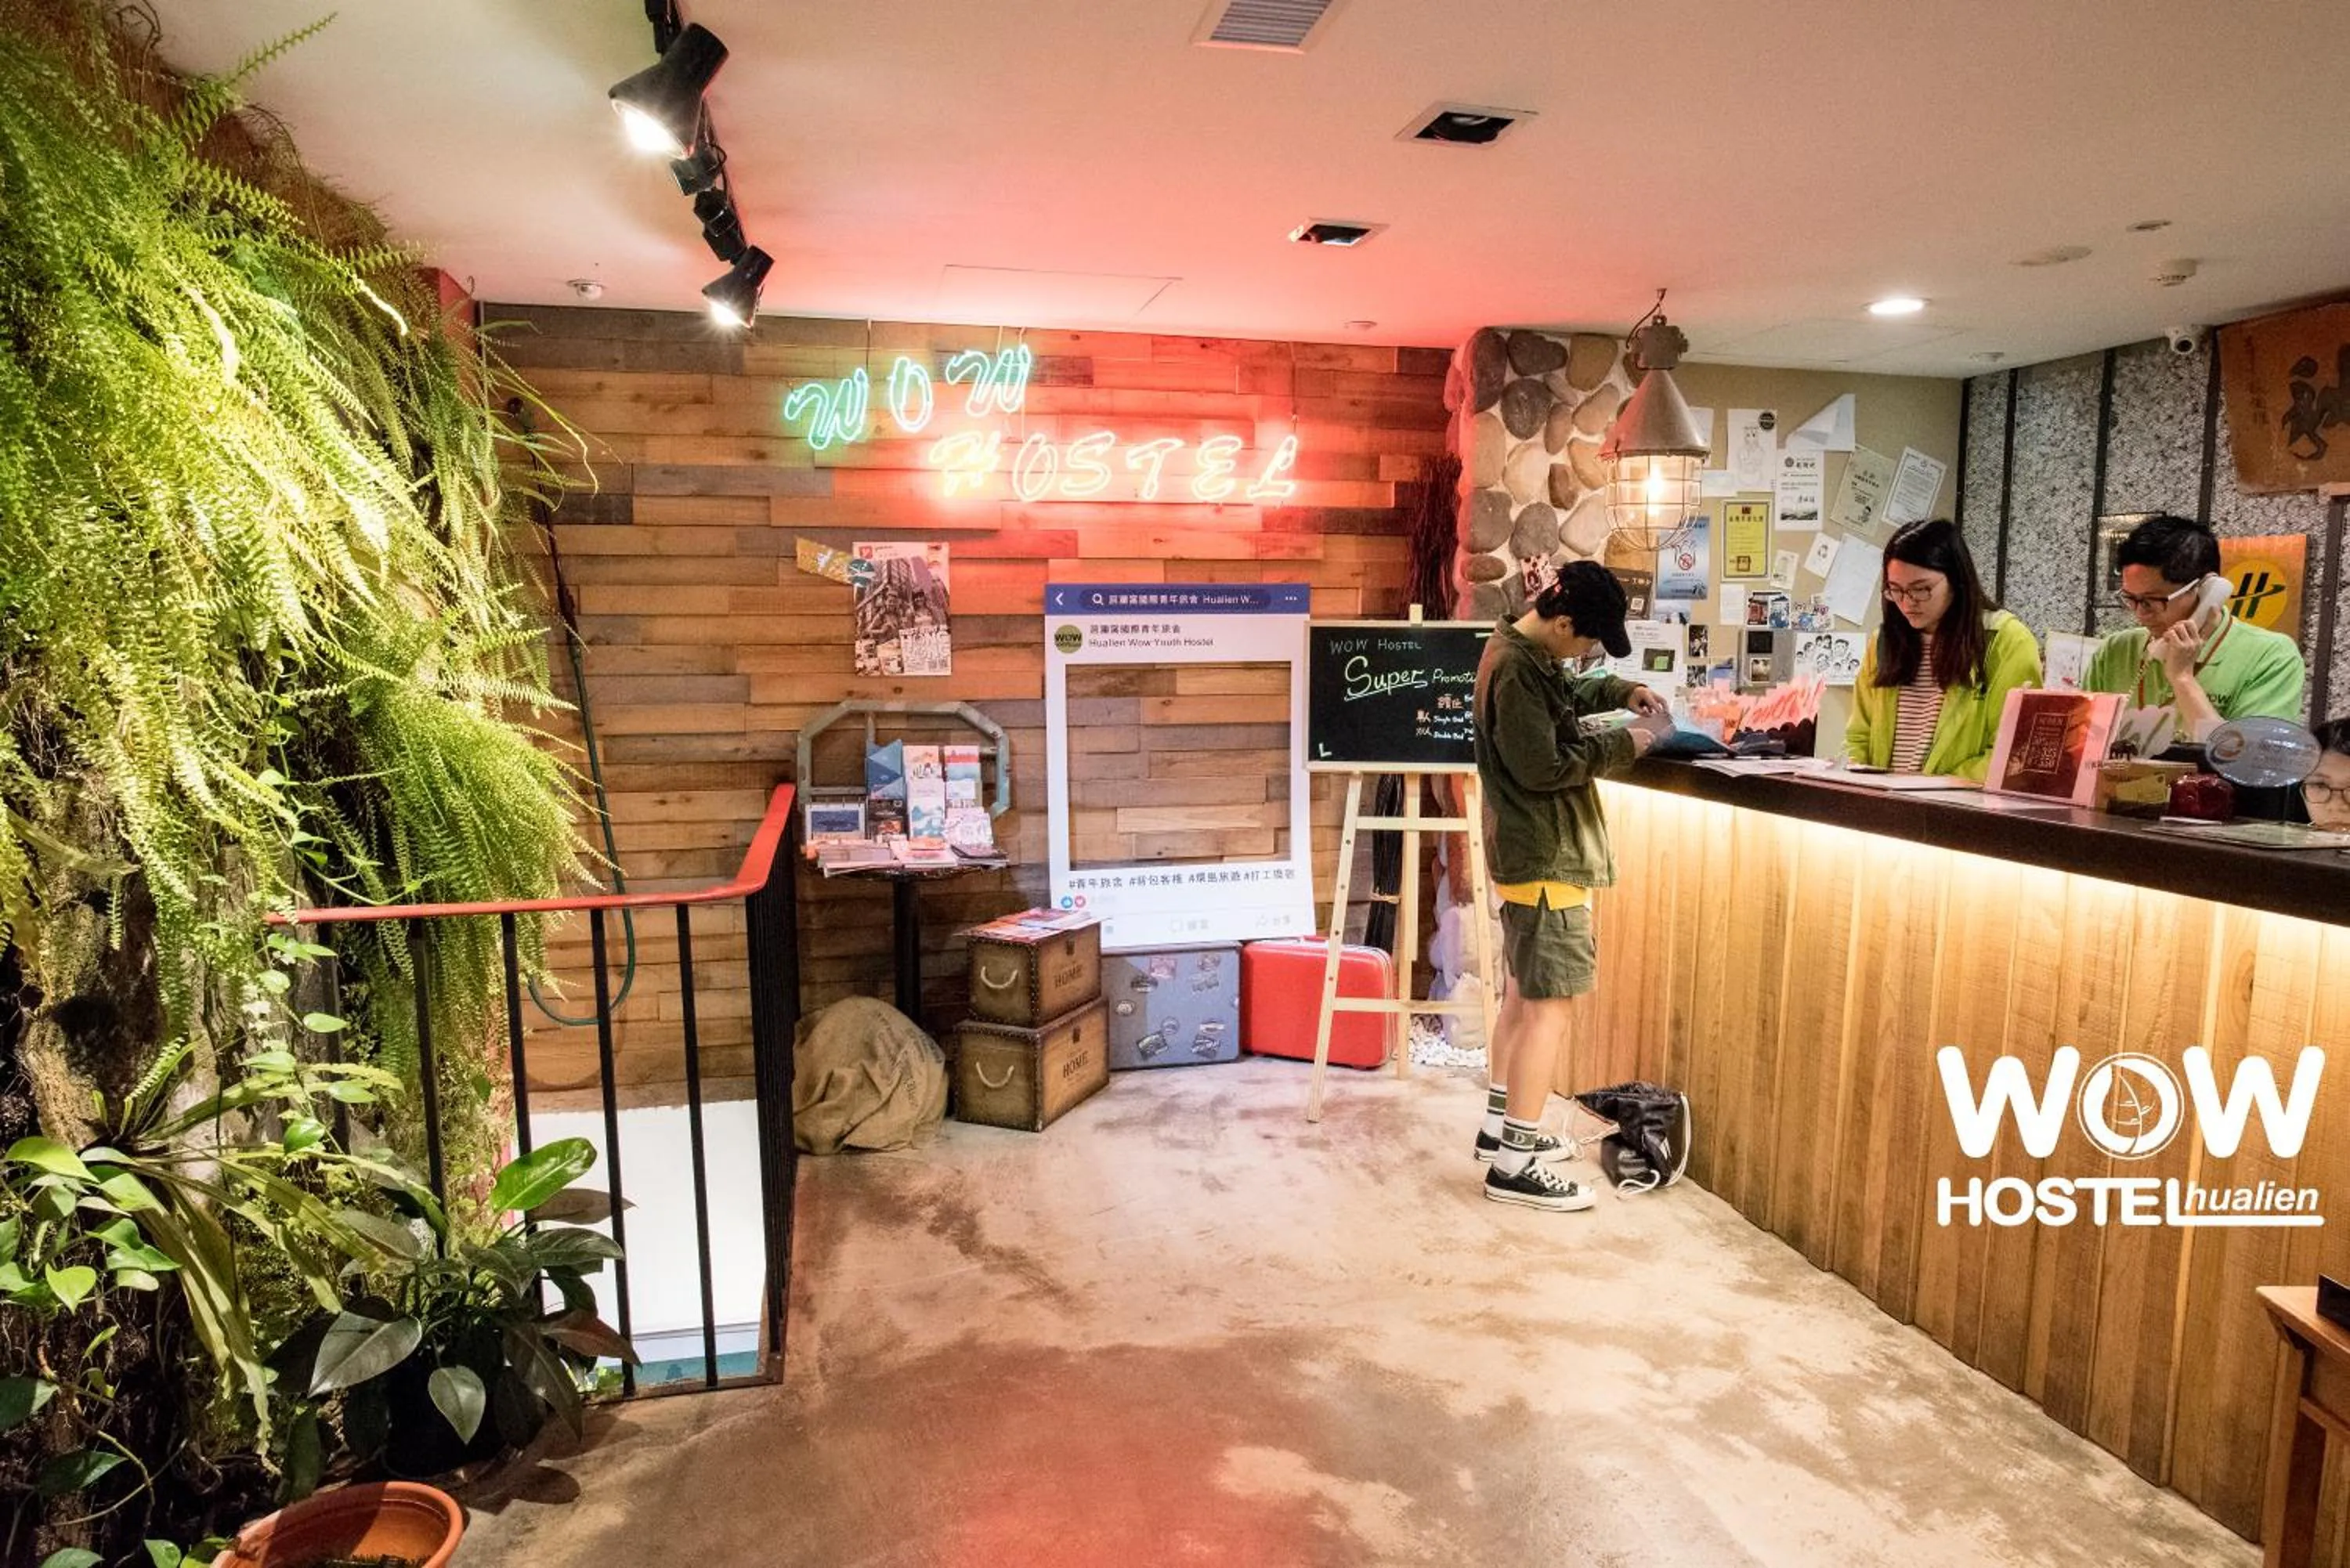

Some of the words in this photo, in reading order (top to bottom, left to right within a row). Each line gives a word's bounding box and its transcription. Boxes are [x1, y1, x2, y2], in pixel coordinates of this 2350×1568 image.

[783, 343, 1032, 451] WOW
[929, 430, 1299, 502] HOSTEL
[1202, 594, 1238, 605] Hualien
[1089, 637, 1126, 648] Hualien
[1128, 637, 1152, 647] Wow
[1153, 636, 1182, 647] Youth
[1184, 636, 1214, 647] Hostel
[1329, 638, 1369, 655] WOW
[1344, 656, 1426, 697] Super
[1054, 964, 1084, 988] HOME
[1062, 1050, 1089, 1078] HOME
